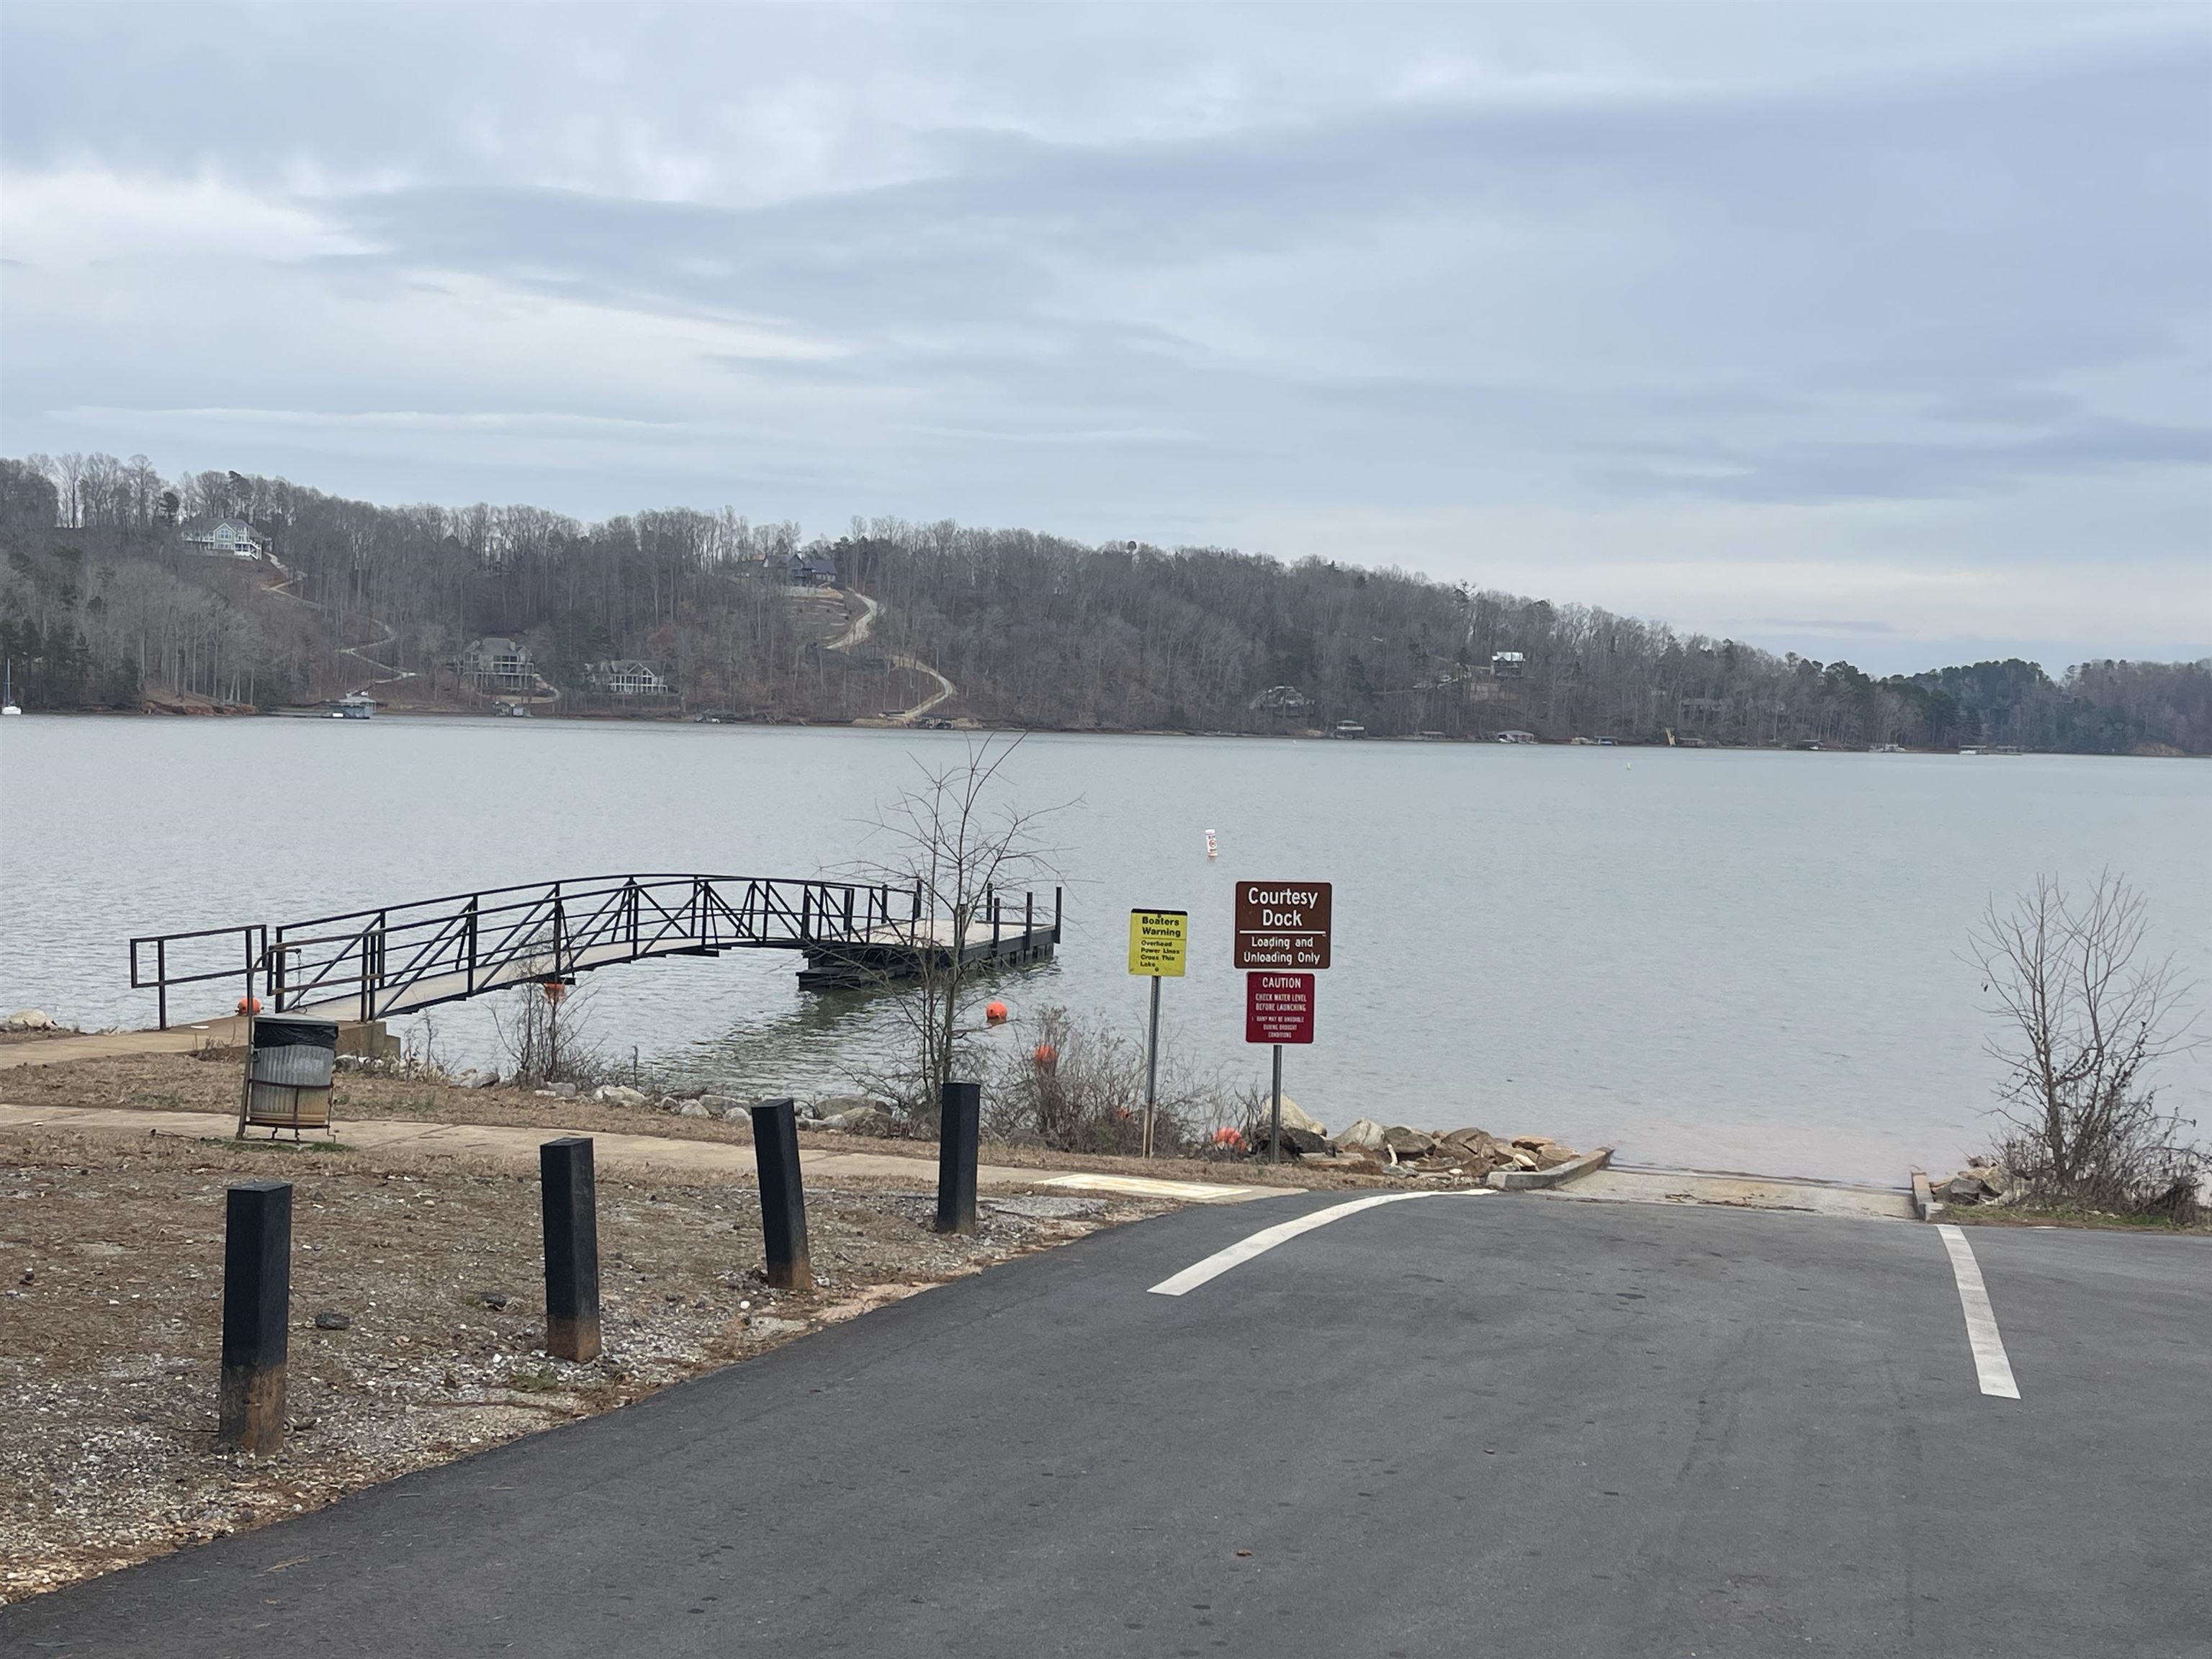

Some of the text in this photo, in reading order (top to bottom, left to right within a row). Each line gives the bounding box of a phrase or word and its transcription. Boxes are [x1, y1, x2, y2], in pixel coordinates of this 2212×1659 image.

[1248, 886, 1318, 909] Courtesy
[1142, 916, 1179, 926] Boaters
[1262, 909, 1303, 926] Dock
[1142, 927, 1181, 938] Warning
[1251, 936, 1313, 950] Loading and
[1244, 951, 1321, 966] Unloading Only
[1262, 977, 1301, 989] CAUTION
[1277, 1003, 1306, 1012] LAUNCHING
